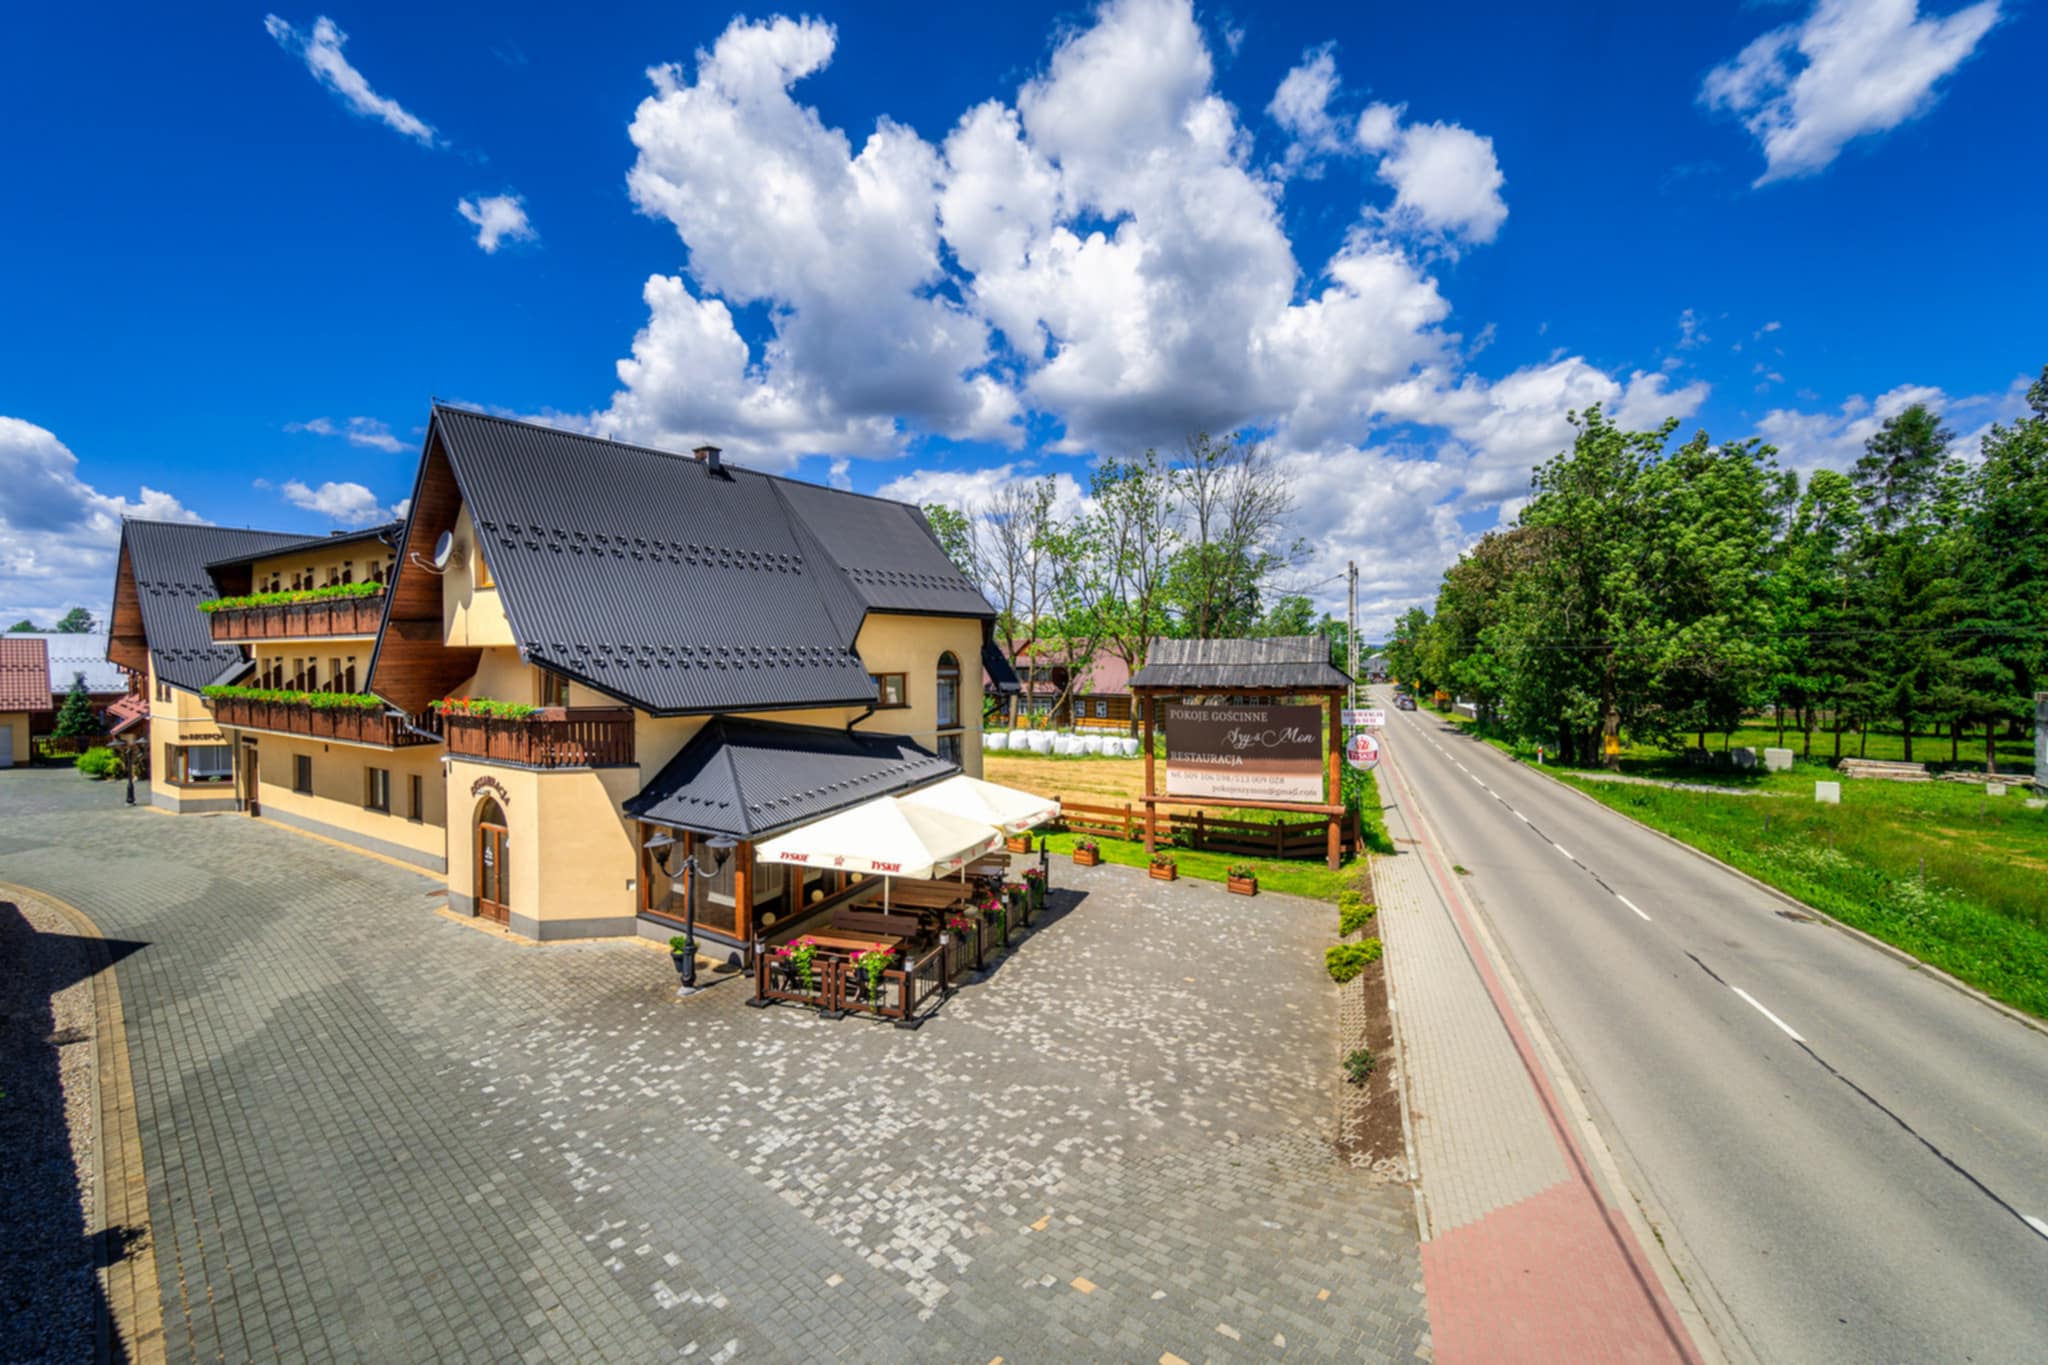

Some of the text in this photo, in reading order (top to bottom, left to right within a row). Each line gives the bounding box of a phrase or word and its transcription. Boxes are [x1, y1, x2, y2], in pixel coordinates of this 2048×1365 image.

[1170, 709, 1268, 722] POKOJE GOŚCINNE
[1170, 752, 1243, 766] RESTAURACJA
[780, 851, 809, 862] TYSKIE
[871, 860, 902, 872] TYSKIE
